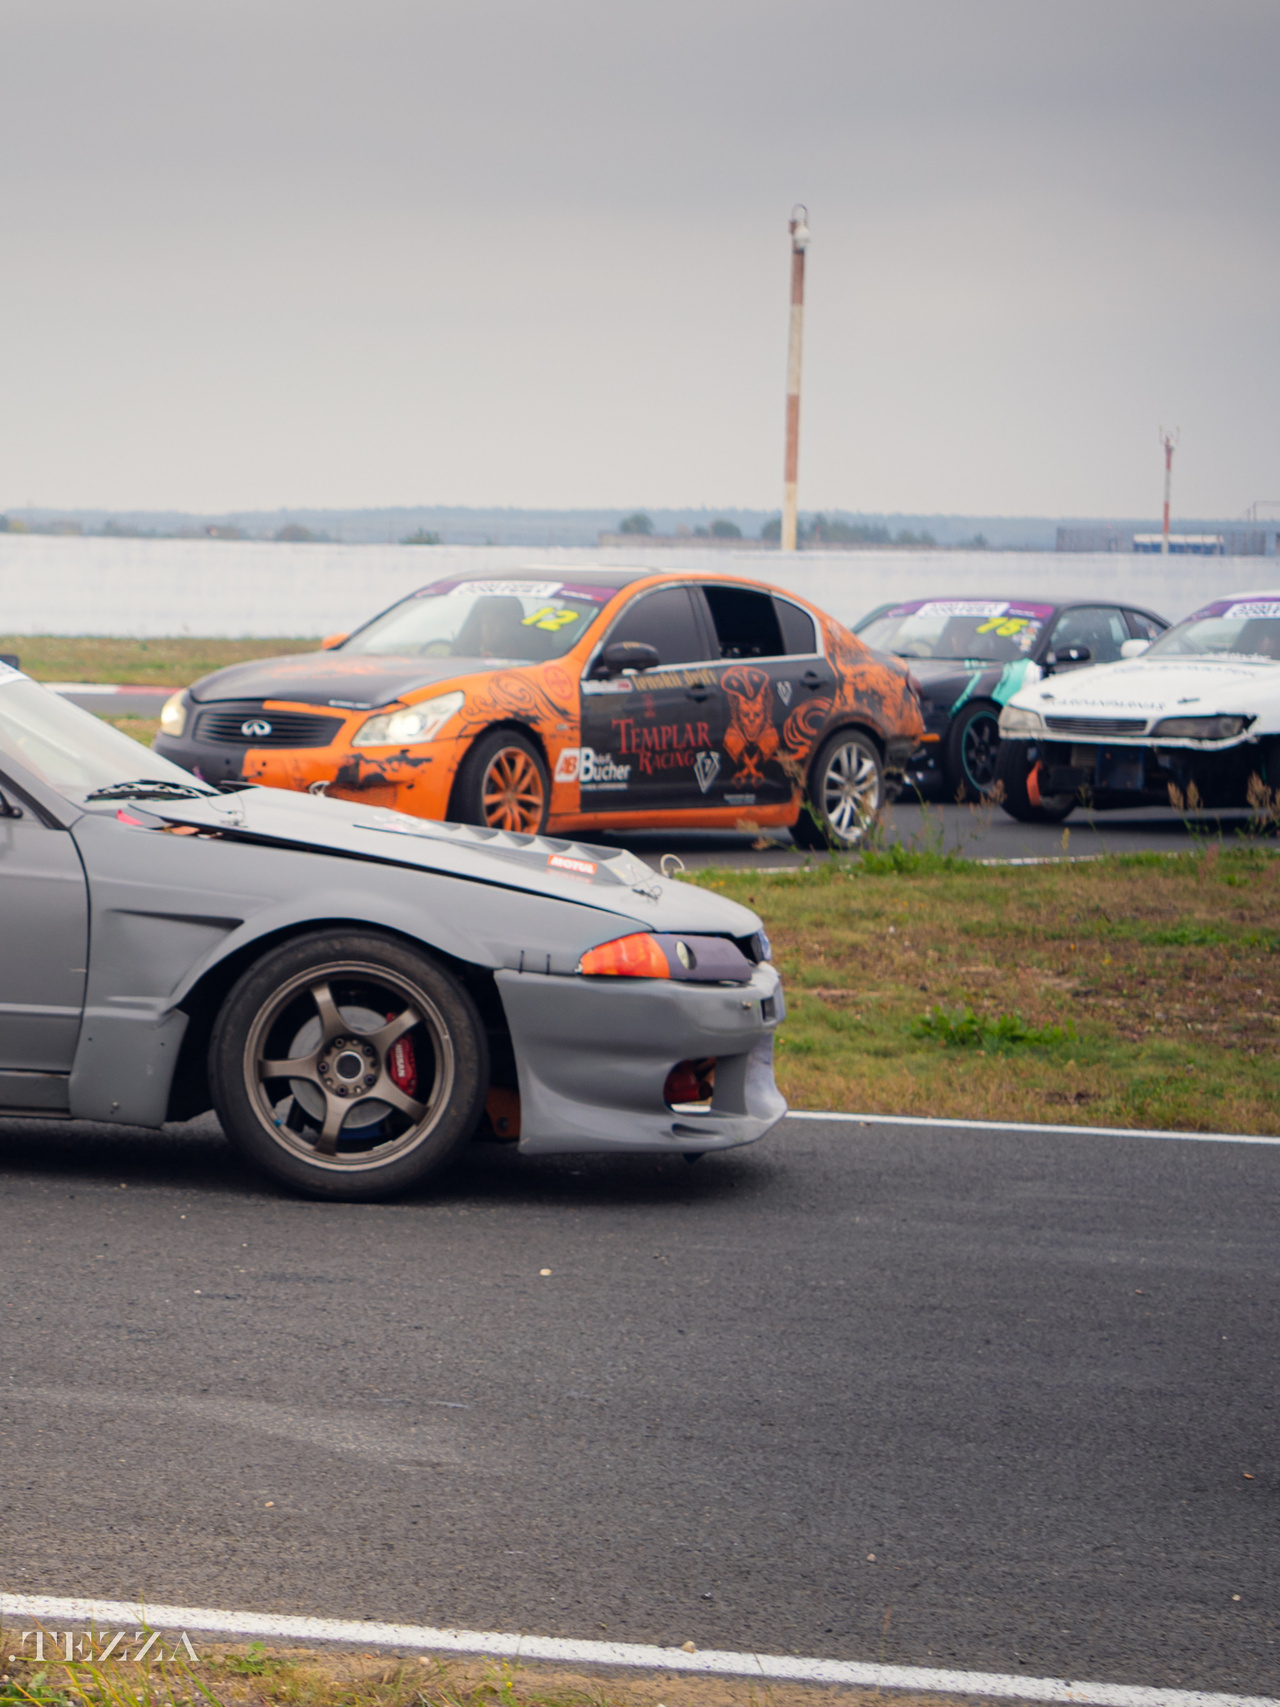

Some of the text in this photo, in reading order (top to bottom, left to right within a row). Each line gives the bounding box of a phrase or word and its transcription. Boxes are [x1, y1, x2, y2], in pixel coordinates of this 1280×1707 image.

[522, 607, 579, 632] 12
[976, 617, 1029, 637] 75
[550, 856, 594, 874] MOTUL
[395, 1044, 406, 1078] NISSAN
